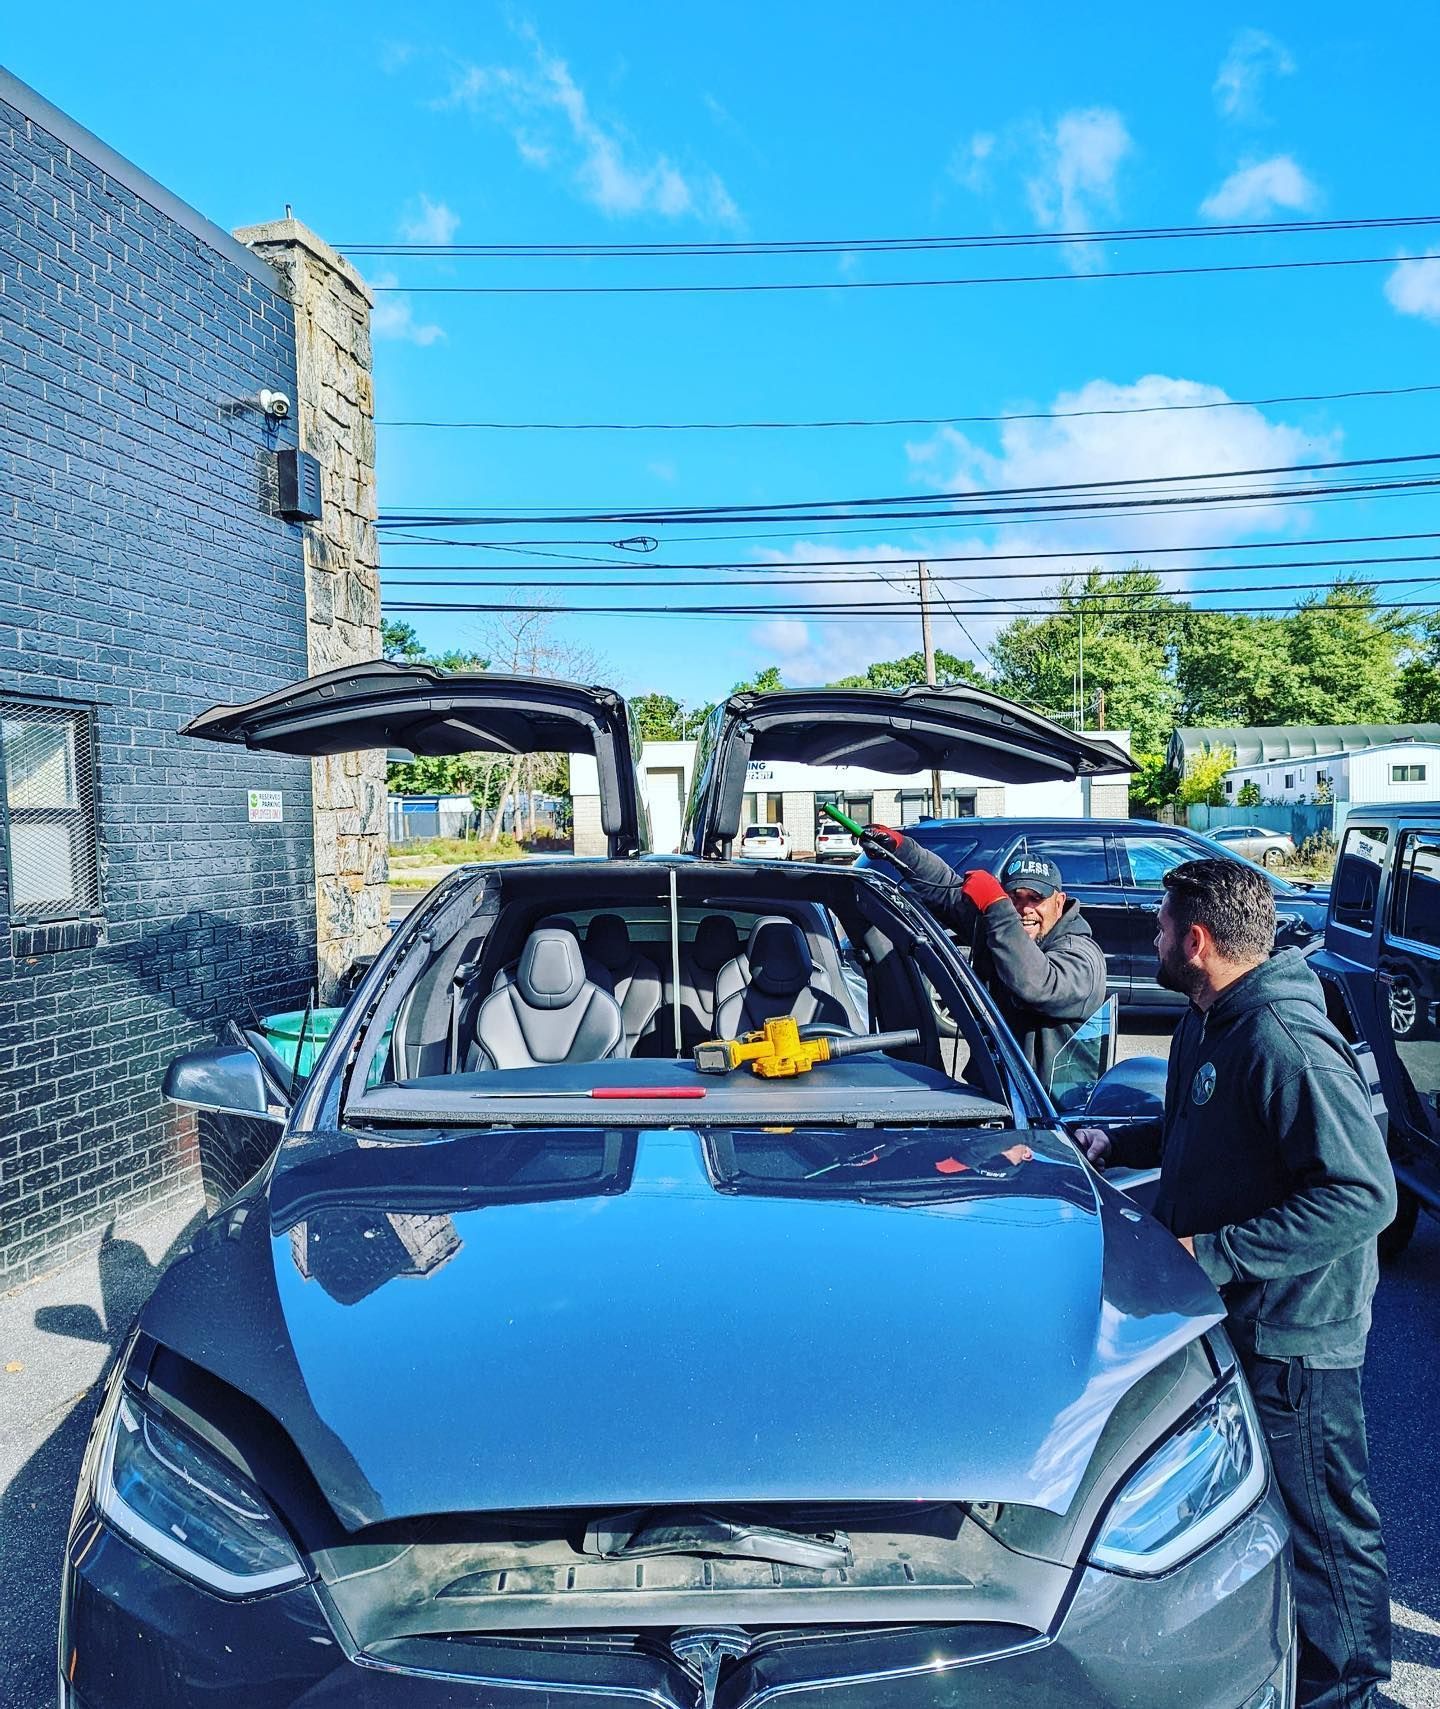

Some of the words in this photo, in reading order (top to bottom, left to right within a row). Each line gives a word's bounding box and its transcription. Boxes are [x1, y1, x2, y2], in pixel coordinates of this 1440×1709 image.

[747, 762, 767, 770] ING
[258, 792, 281, 800] RESERVED
[1020, 861, 1049, 875] LESS
